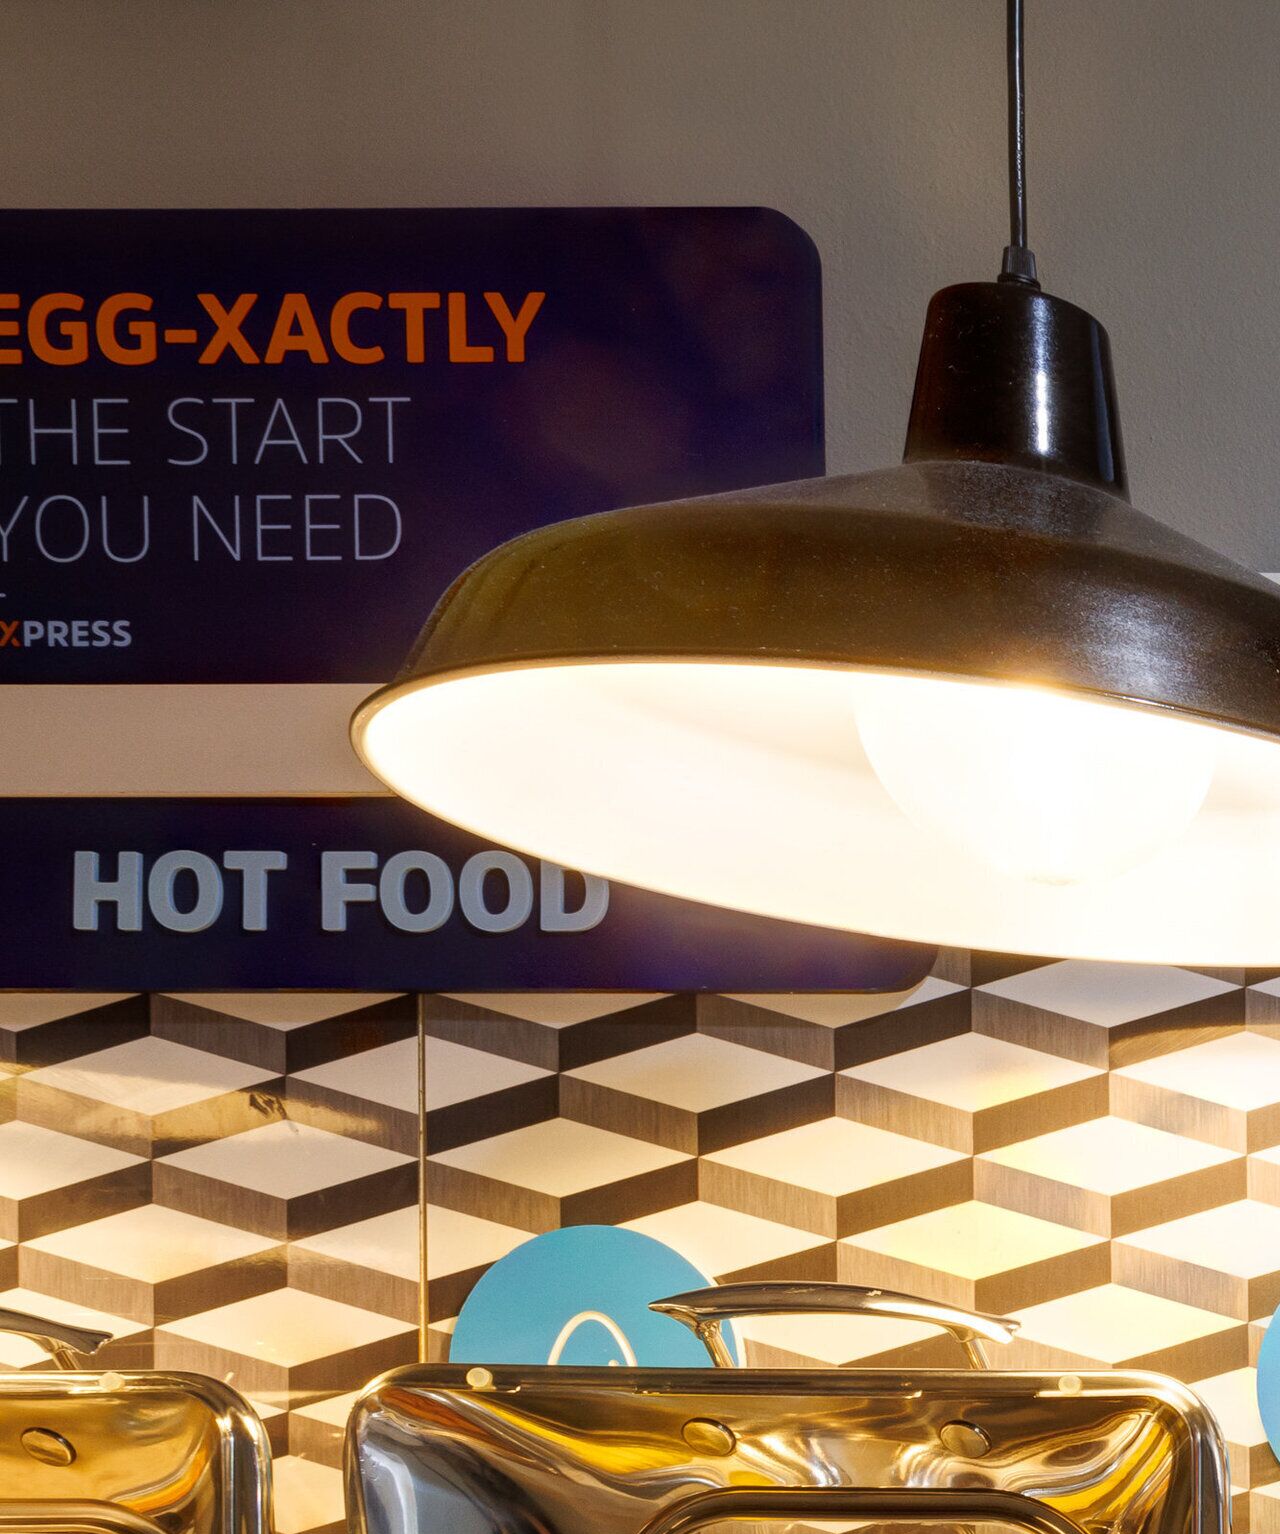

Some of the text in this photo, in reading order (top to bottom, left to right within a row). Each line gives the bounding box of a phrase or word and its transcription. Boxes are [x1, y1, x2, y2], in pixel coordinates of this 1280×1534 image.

[166, 396, 411, 465] START
[191, 494, 403, 562] NEED
[72, 850, 610, 933] HOT FOOD
